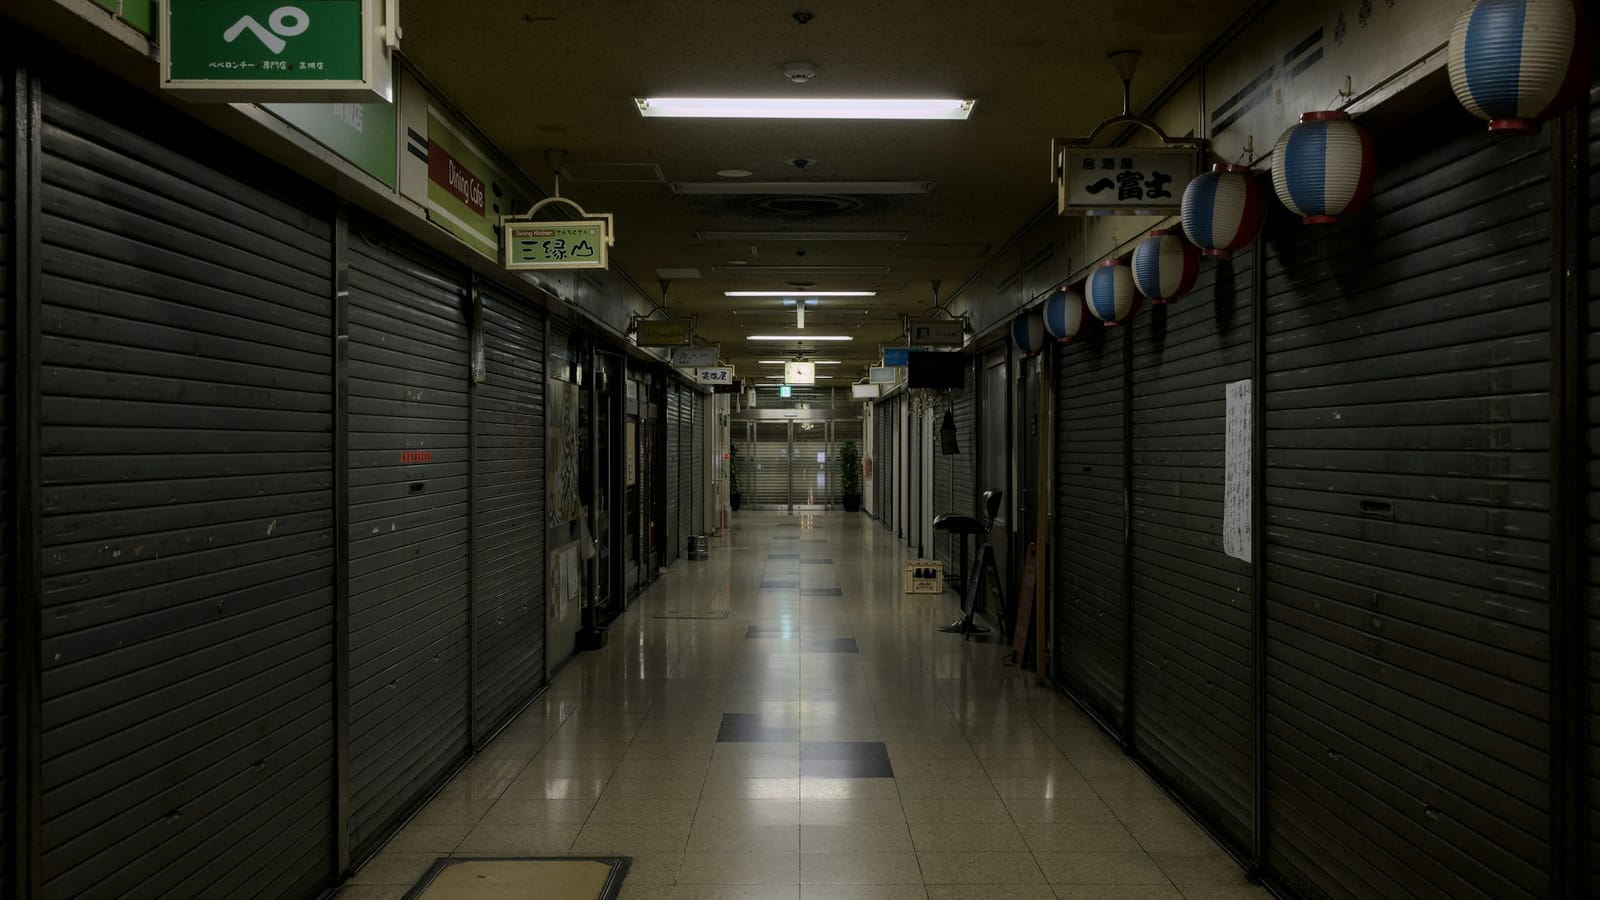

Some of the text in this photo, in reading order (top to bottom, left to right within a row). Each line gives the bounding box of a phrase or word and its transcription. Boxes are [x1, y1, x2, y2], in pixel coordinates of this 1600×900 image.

[223, 6, 310, 54] ペ
[448, 159, 484, 208] Dining Cafe
[1086, 170, 1172, 201] 一富士
